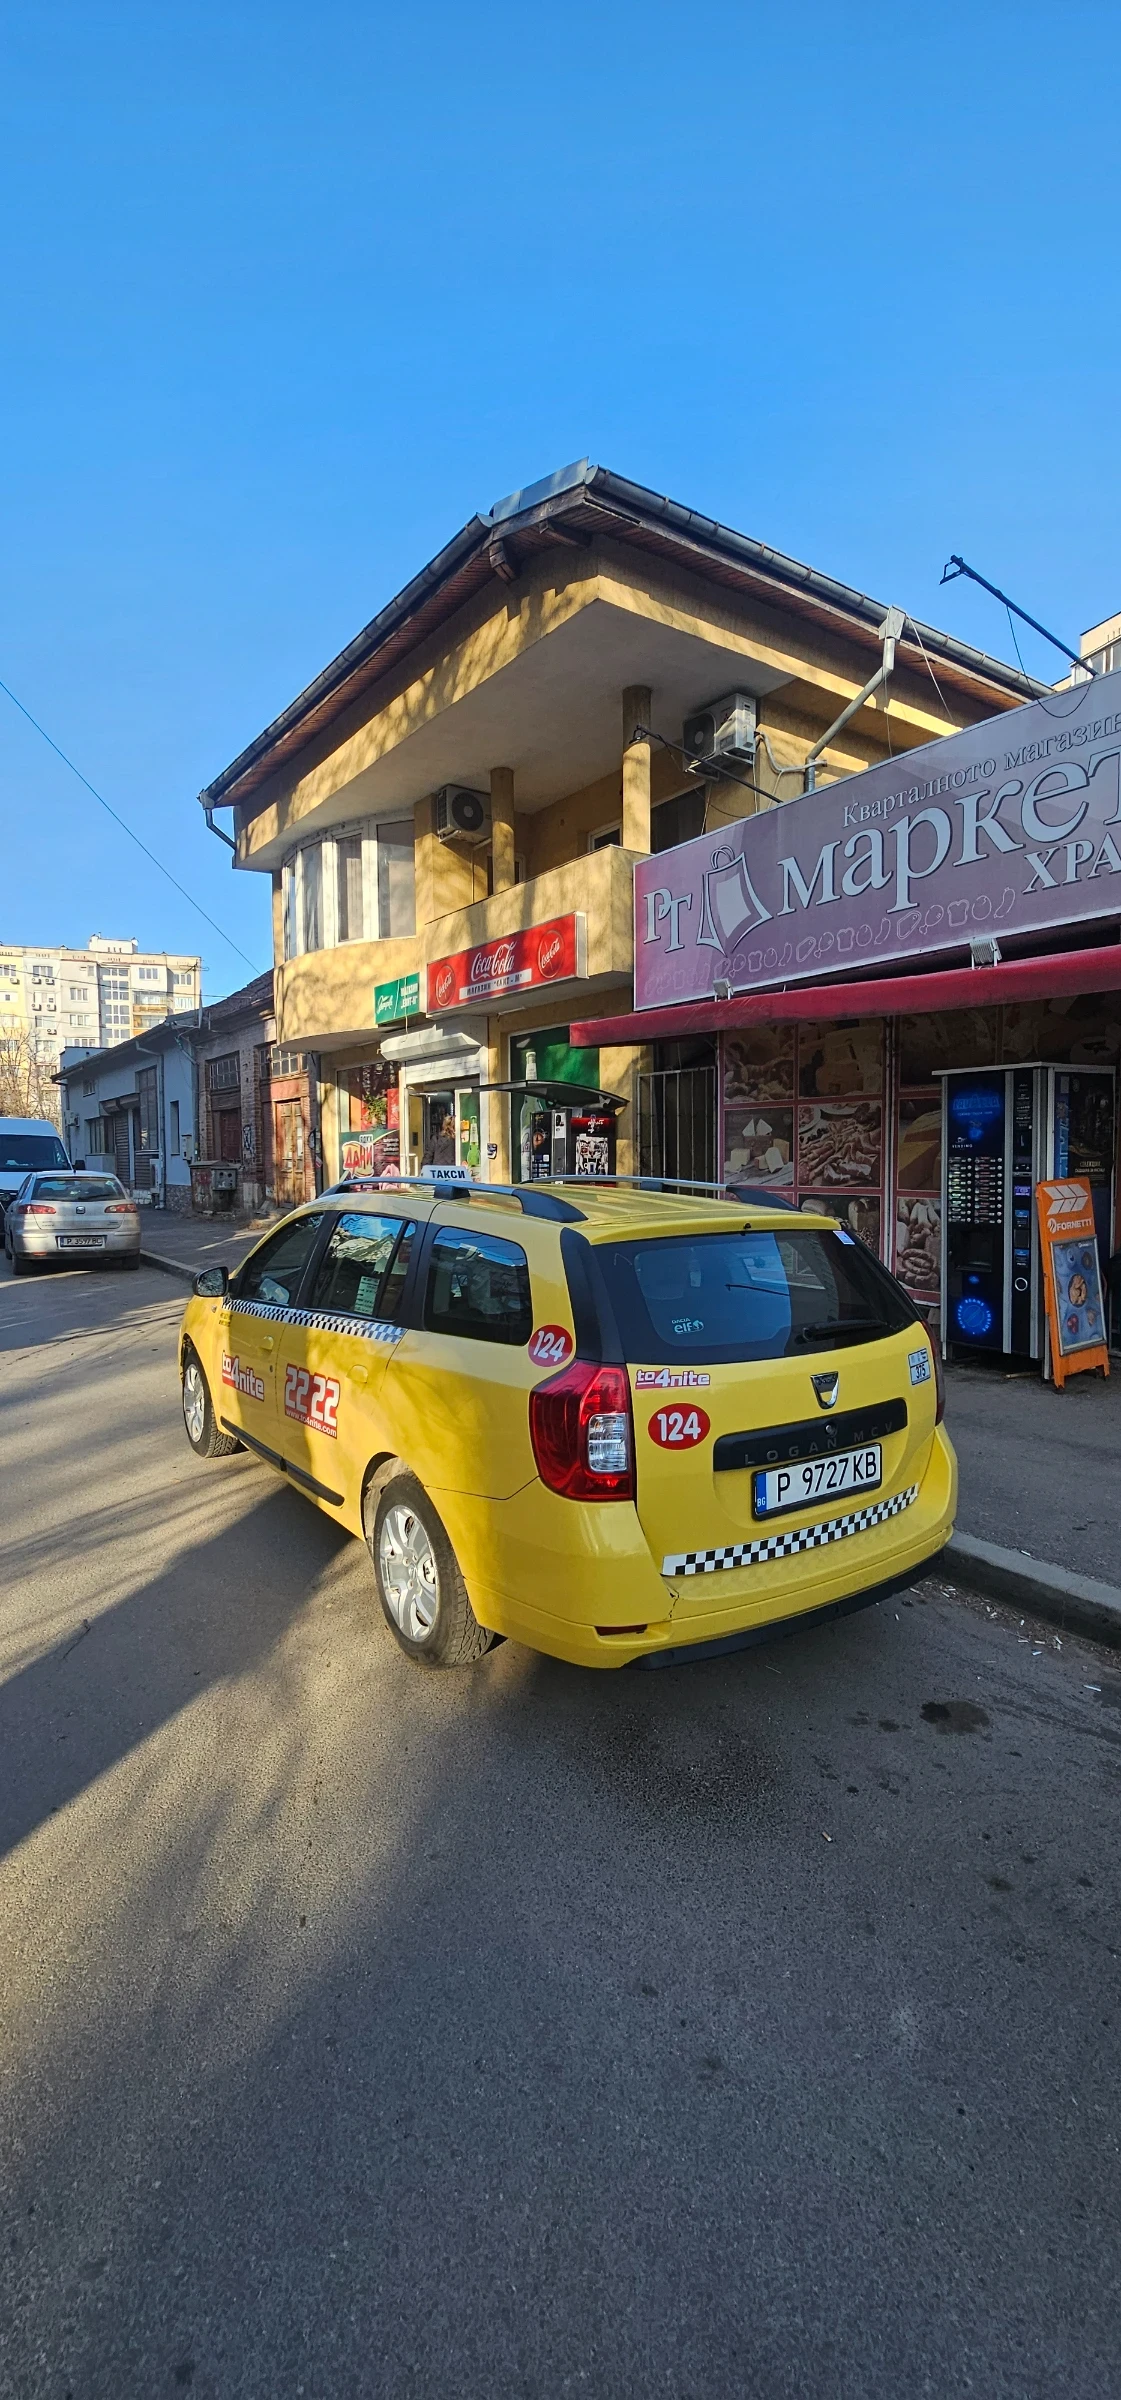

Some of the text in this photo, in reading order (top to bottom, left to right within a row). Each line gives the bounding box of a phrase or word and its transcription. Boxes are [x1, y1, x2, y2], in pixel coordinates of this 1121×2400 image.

[843, 757, 997, 828] Кварталното
[471, 941, 518, 982] Coca-Cola
[430, 1170, 466, 1179] ТАКСИ
[1056, 1219, 1092, 1231] FORNETTI
[674, 1321, 693, 1333] elf
[533, 1330, 566, 1362] 124
[222, 1350, 265, 1402] to4nite
[636, 1368, 710, 1387] to4nite
[286, 1409, 337, 1437] www.to4nite.com
[657, 1411, 702, 1442] 124
[744, 1438, 837, 1465] LOGAN
[777, 1451, 877, 1503] P 9727 KB
[756, 1496, 766, 1508] BG
